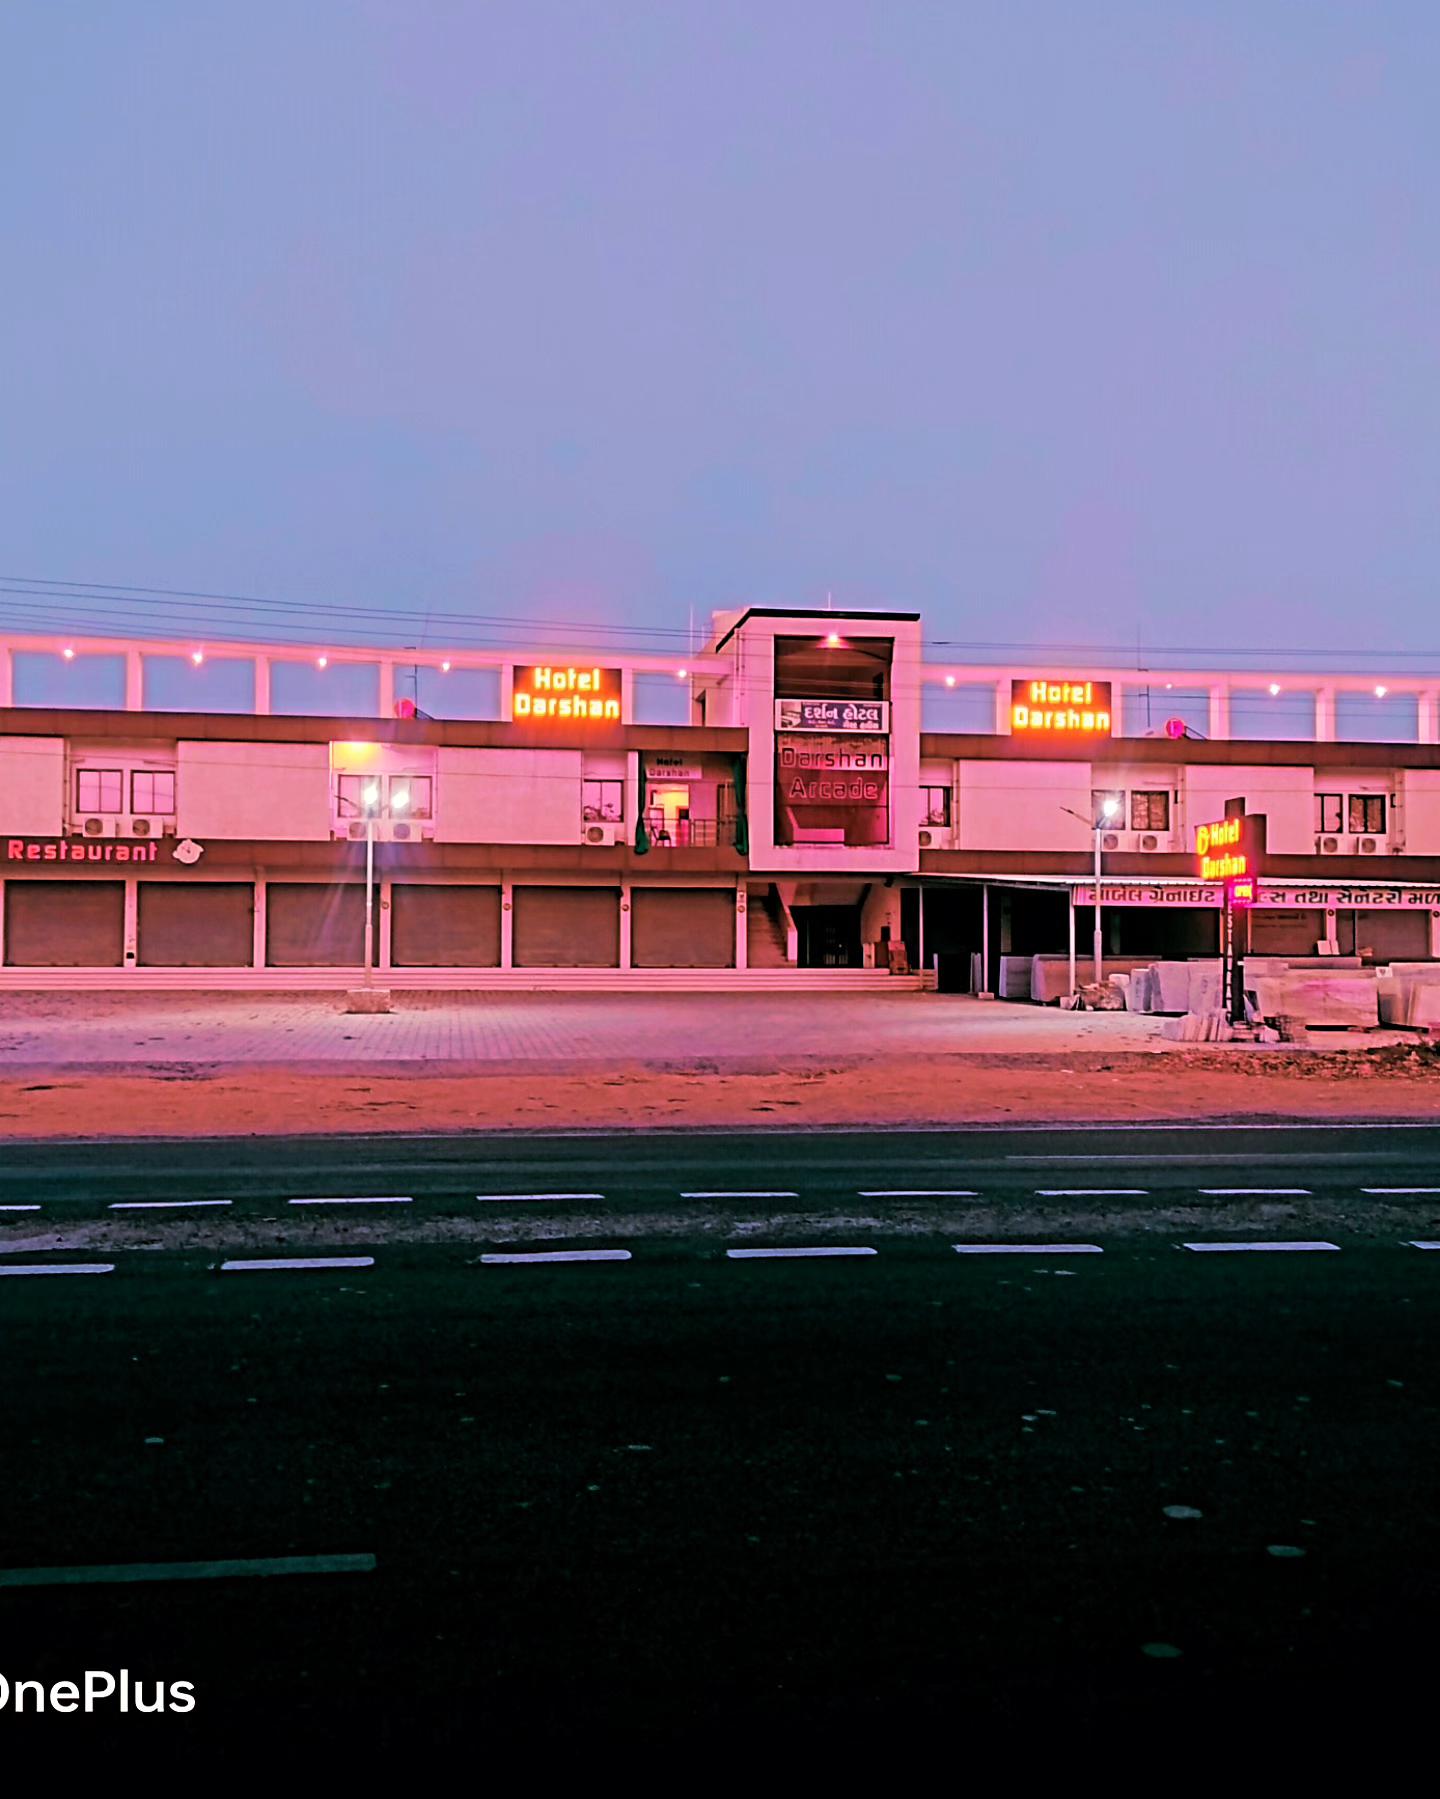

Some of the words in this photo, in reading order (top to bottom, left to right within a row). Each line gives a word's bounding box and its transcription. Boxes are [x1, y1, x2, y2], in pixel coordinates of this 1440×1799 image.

[535, 667, 600, 691] Hotel
[1031, 681, 1092, 704] Hotel
[514, 693, 619, 719] Darshan
[804, 703, 838, 720] દર્શન
[843, 703, 879, 721] હોટલ
[1013, 706, 1110, 731] Darshan
[656, 758, 683, 766] Hotel
[781, 746, 882, 768] Darshan
[649, 768, 690, 777] Darshan
[789, 777, 878, 800] Arcade
[1210, 818, 1240, 847] Hotel
[8, 840, 158, 861] Restaurant
[1202, 853, 1246, 879] Darshan
